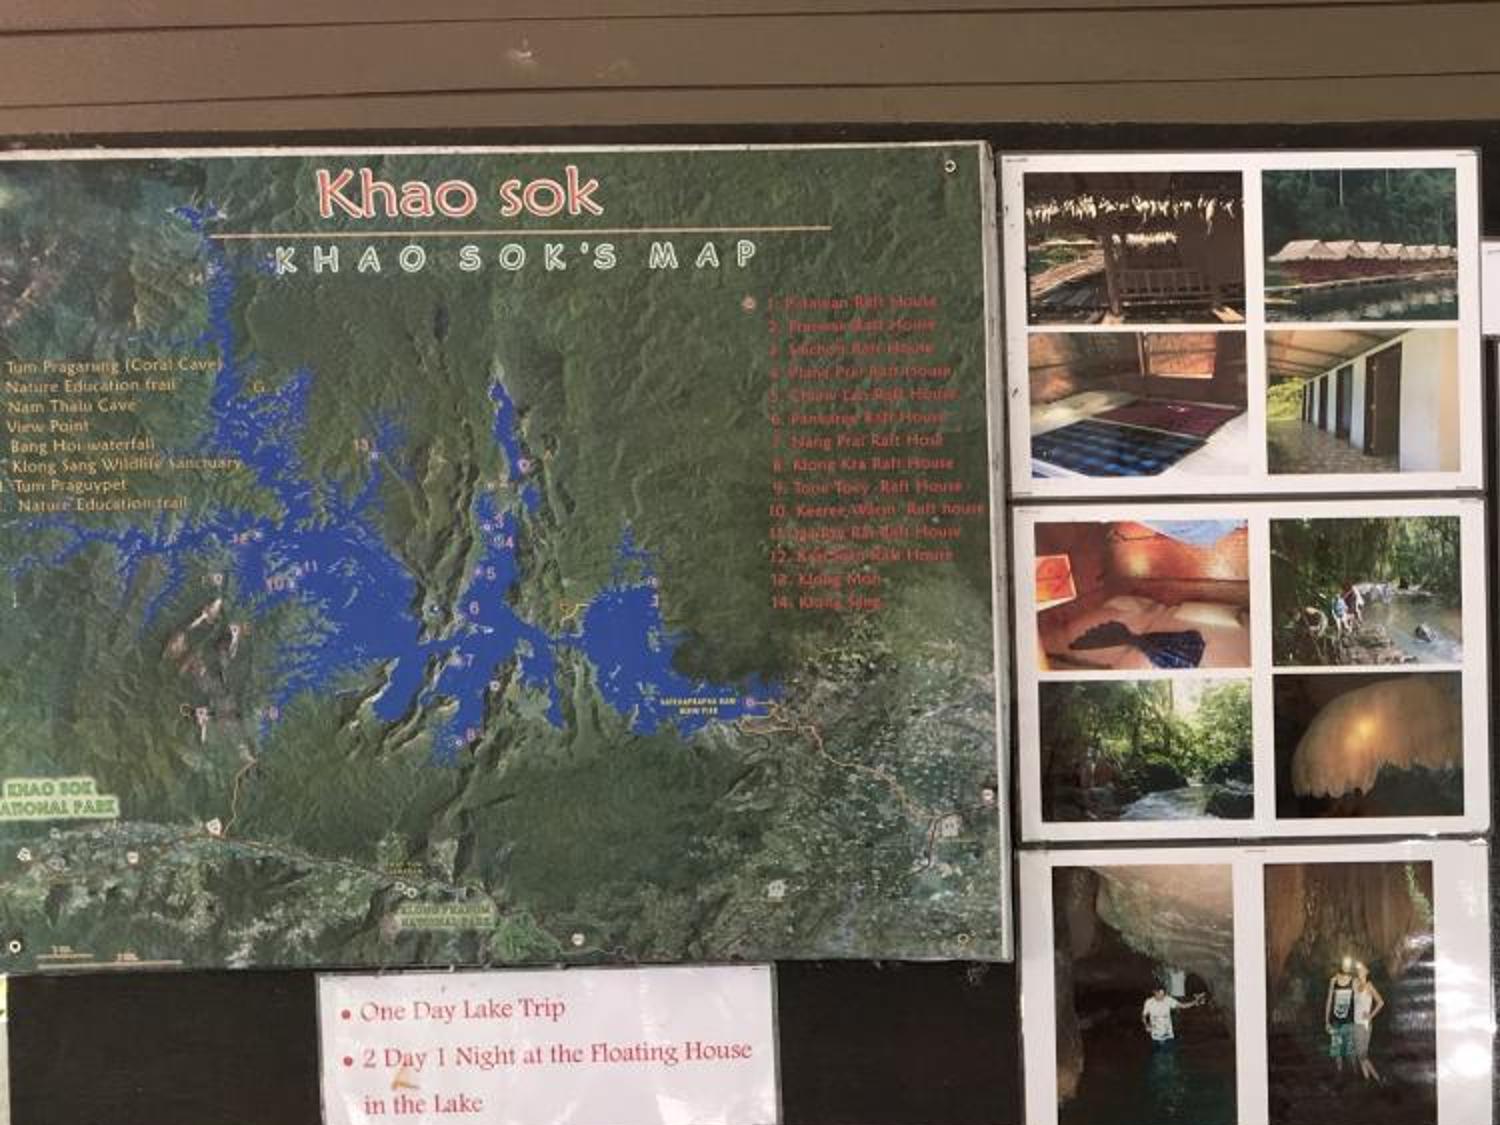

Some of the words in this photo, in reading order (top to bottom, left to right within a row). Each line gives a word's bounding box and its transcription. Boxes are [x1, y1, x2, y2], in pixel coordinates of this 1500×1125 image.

[316, 167, 479, 219] Khao
[497, 165, 604, 217] sok
[275, 244, 427, 276] KHAO
[459, 242, 618, 273] SOK'S
[648, 239, 757, 270] MAP
[4, 381, 60, 394] Nature
[64, 379, 140, 393] Education
[97, 398, 137, 412] Cave
[6, 420, 45, 433] View
[50, 419, 90, 433] Point
[77, 498, 152, 512] Education
[0, 799, 69, 817] ATIONAL
[73, 798, 117, 815] PARK
[360, 1001, 407, 1023] One
[412, 1000, 457, 1026] Day
[463, 999, 513, 1020] Lake
[518, 996, 567, 1023] Trip
[363, 1048, 377, 1070] 2
[384, 1047, 428, 1071] Day
[438, 1047, 447, 1068] 1
[456, 1044, 517, 1071] Night
[522, 1045, 544, 1065] at
[550, 1043, 584, 1065] the
[591, 1040, 680, 1067] Floating
[685, 1039, 754, 1062] House
[363, 1094, 386, 1116] in
[393, 1094, 426, 1115] the
[434, 1092, 484, 1114] Lake
